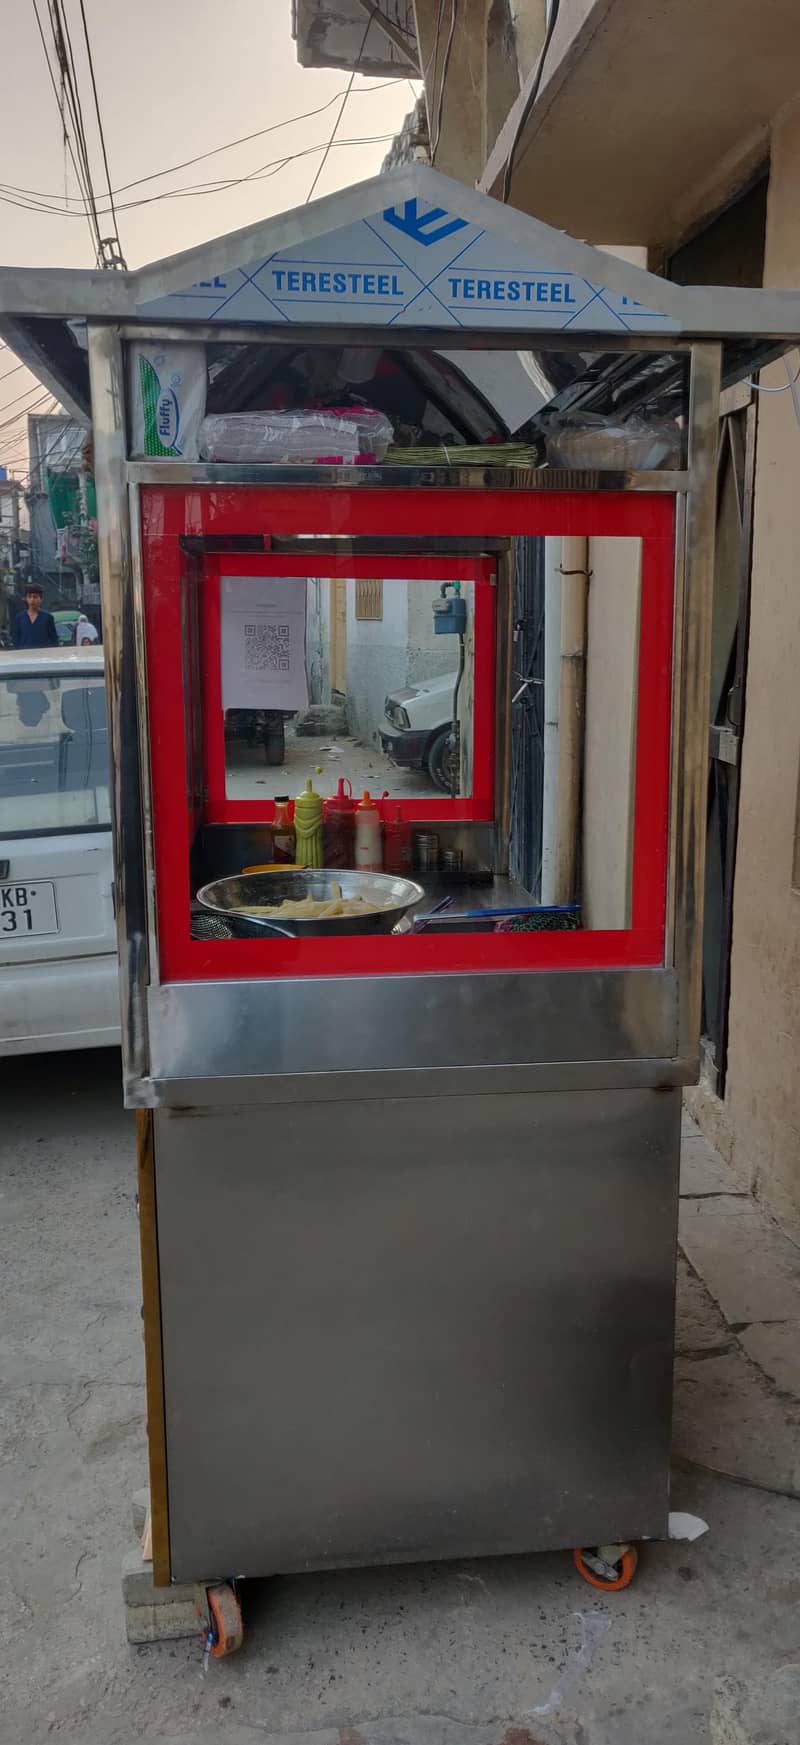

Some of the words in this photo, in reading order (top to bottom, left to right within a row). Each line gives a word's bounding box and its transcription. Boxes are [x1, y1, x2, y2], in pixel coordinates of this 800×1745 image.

[272, 270, 404, 295] TERESTEEL
[448, 278, 576, 304] TERESTEEL
[159, 399, 173, 436] Fluffy
[1, 909, 33, 932] 31
